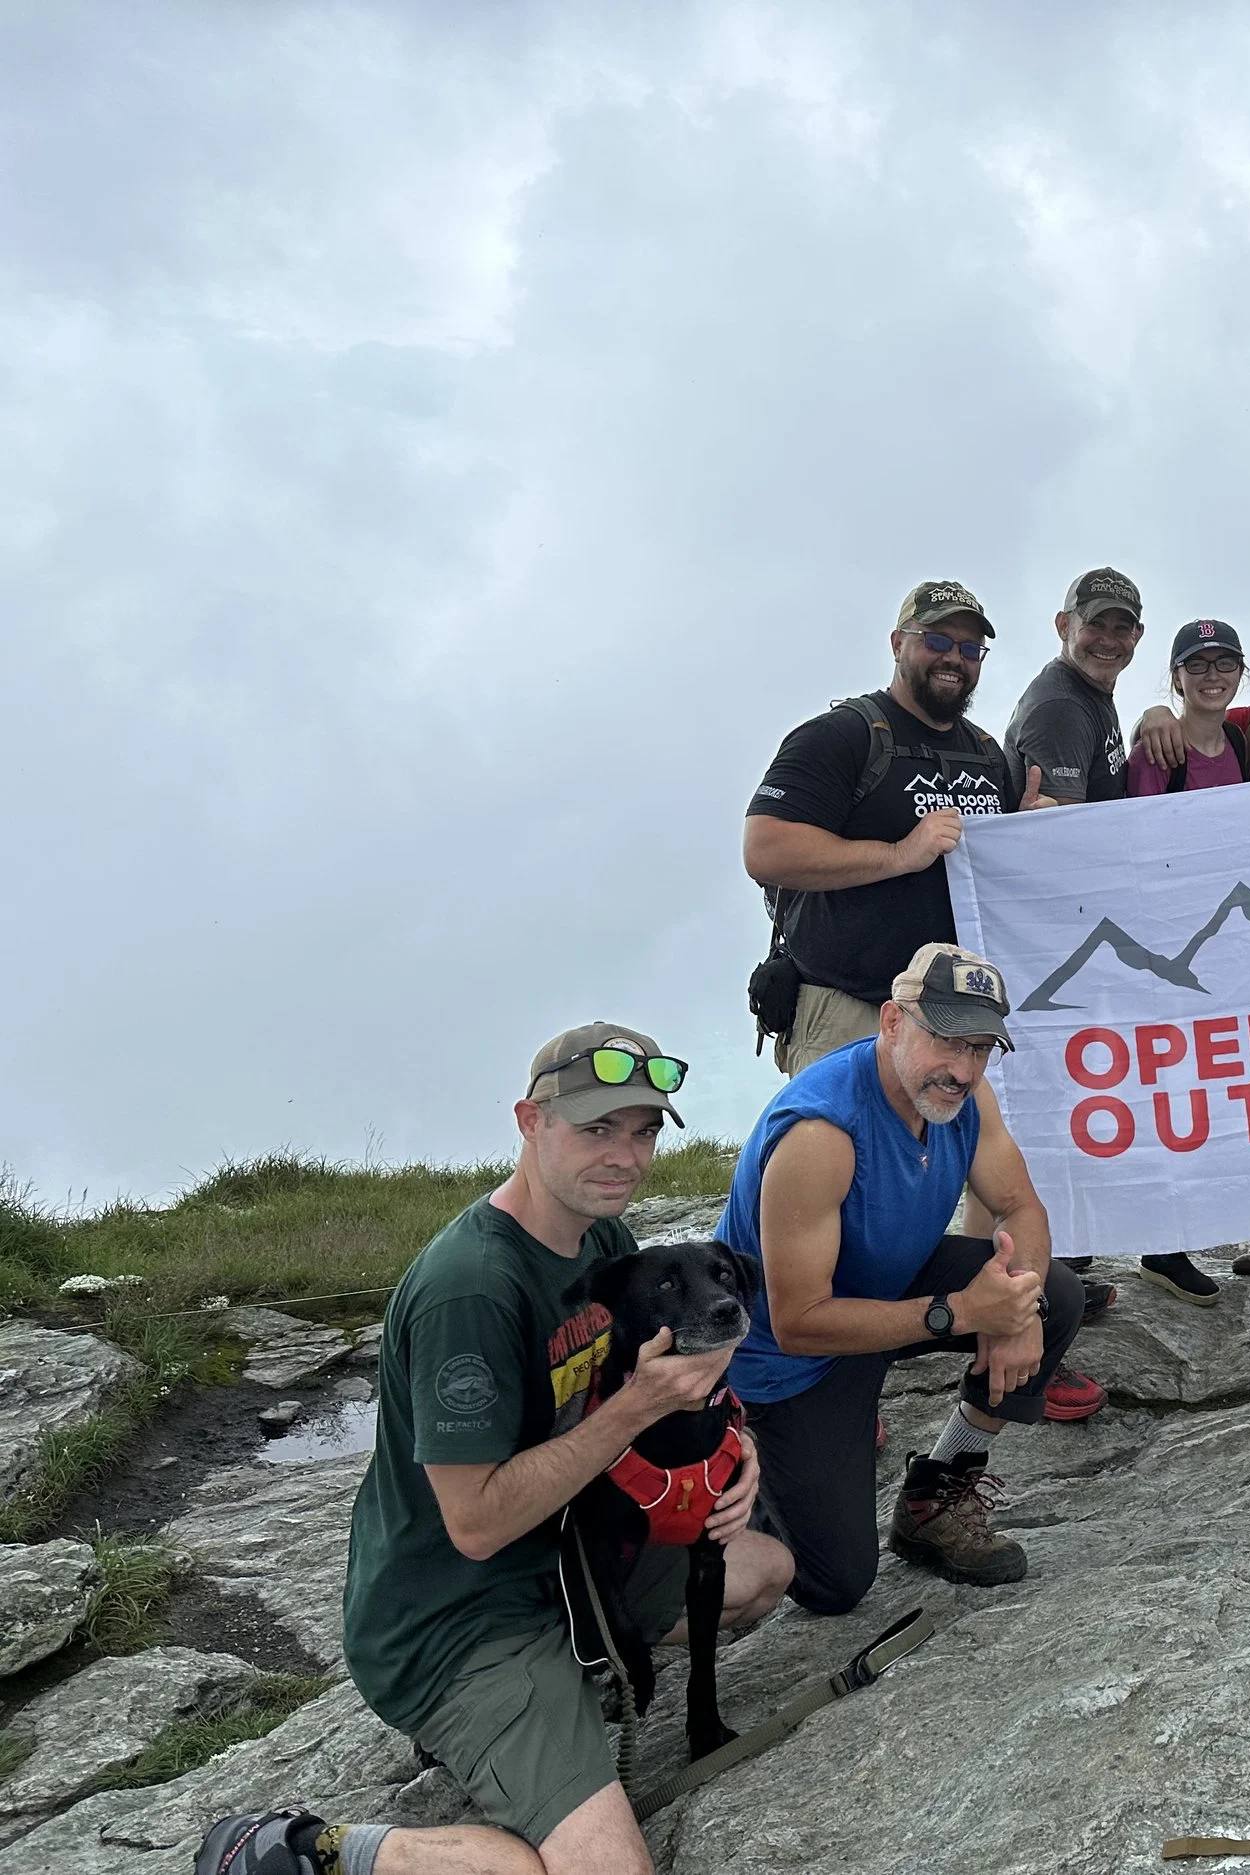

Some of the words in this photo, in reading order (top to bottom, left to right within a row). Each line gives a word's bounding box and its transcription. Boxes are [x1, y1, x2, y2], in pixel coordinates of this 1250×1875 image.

[1198, 623, 1215, 638] B
[913, 792, 954, 807] OPEN
[957, 794, 1000, 807] DOORS
